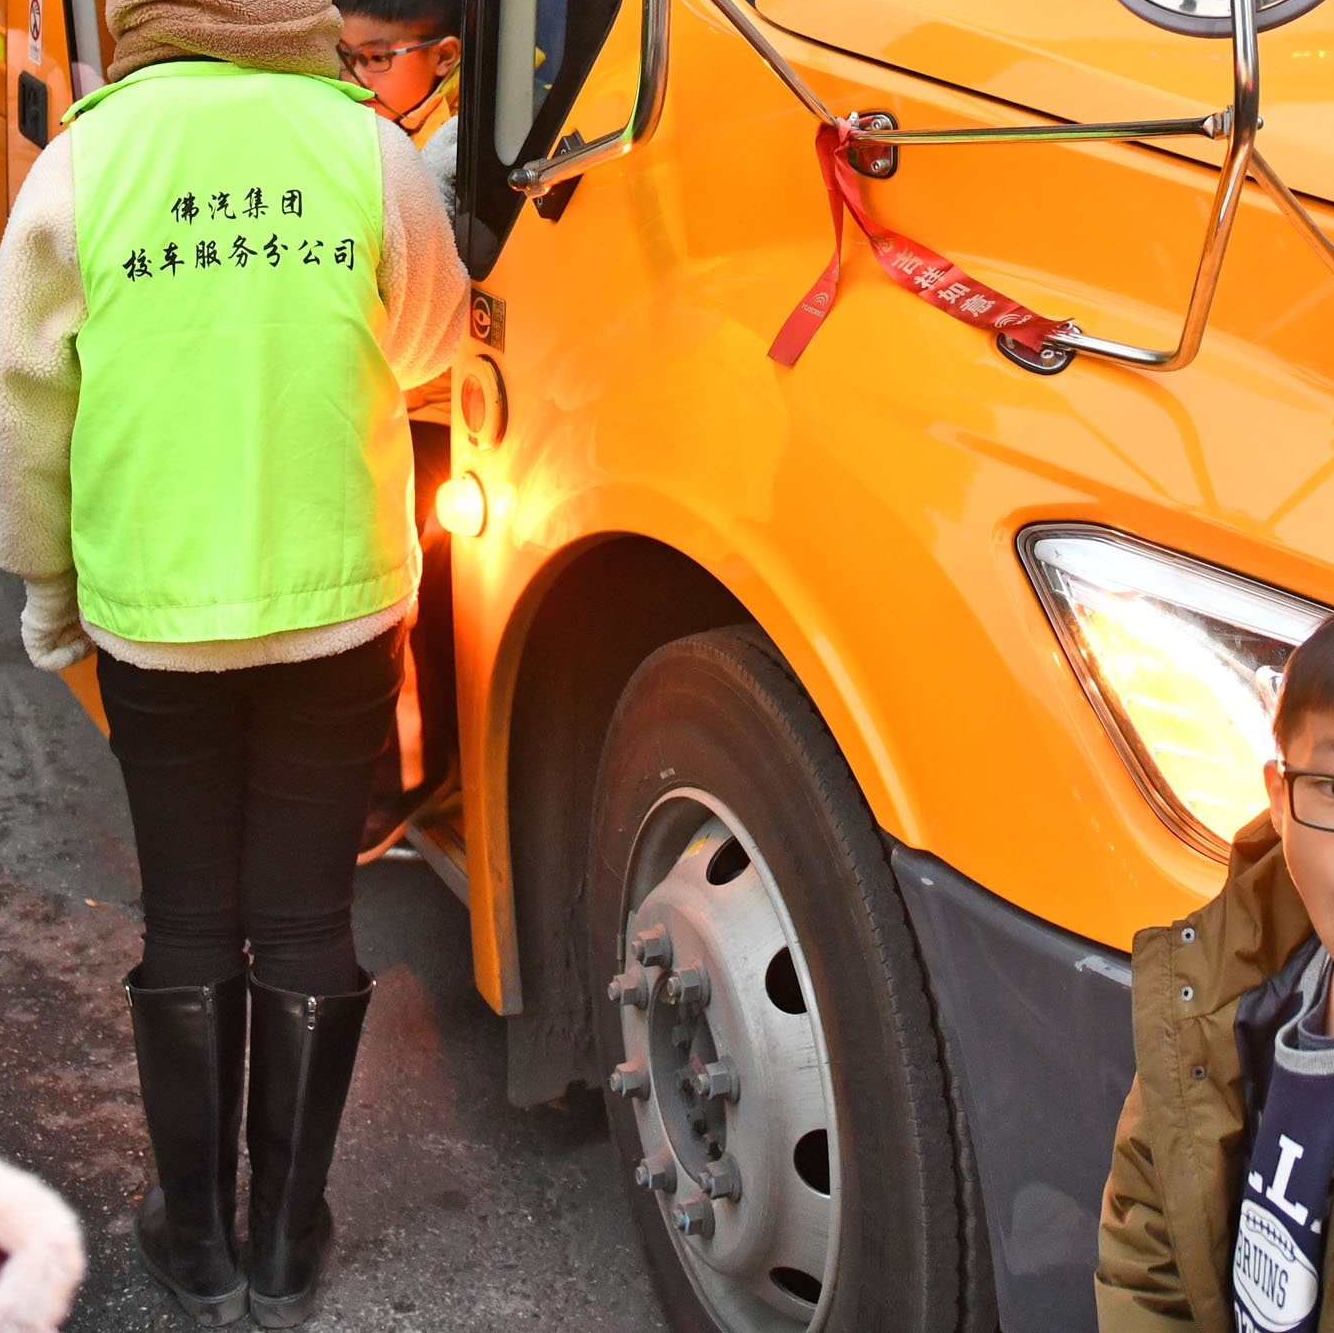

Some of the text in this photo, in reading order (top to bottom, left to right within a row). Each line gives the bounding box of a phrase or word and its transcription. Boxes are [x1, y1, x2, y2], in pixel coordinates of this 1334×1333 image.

[170, 187, 304, 226] 佛汽集团
[122, 233, 356, 282] 校车服务分公司
[891, 248, 996, 318] 吉祥如意
[1235, 1229, 1291, 1311] BRUINS
